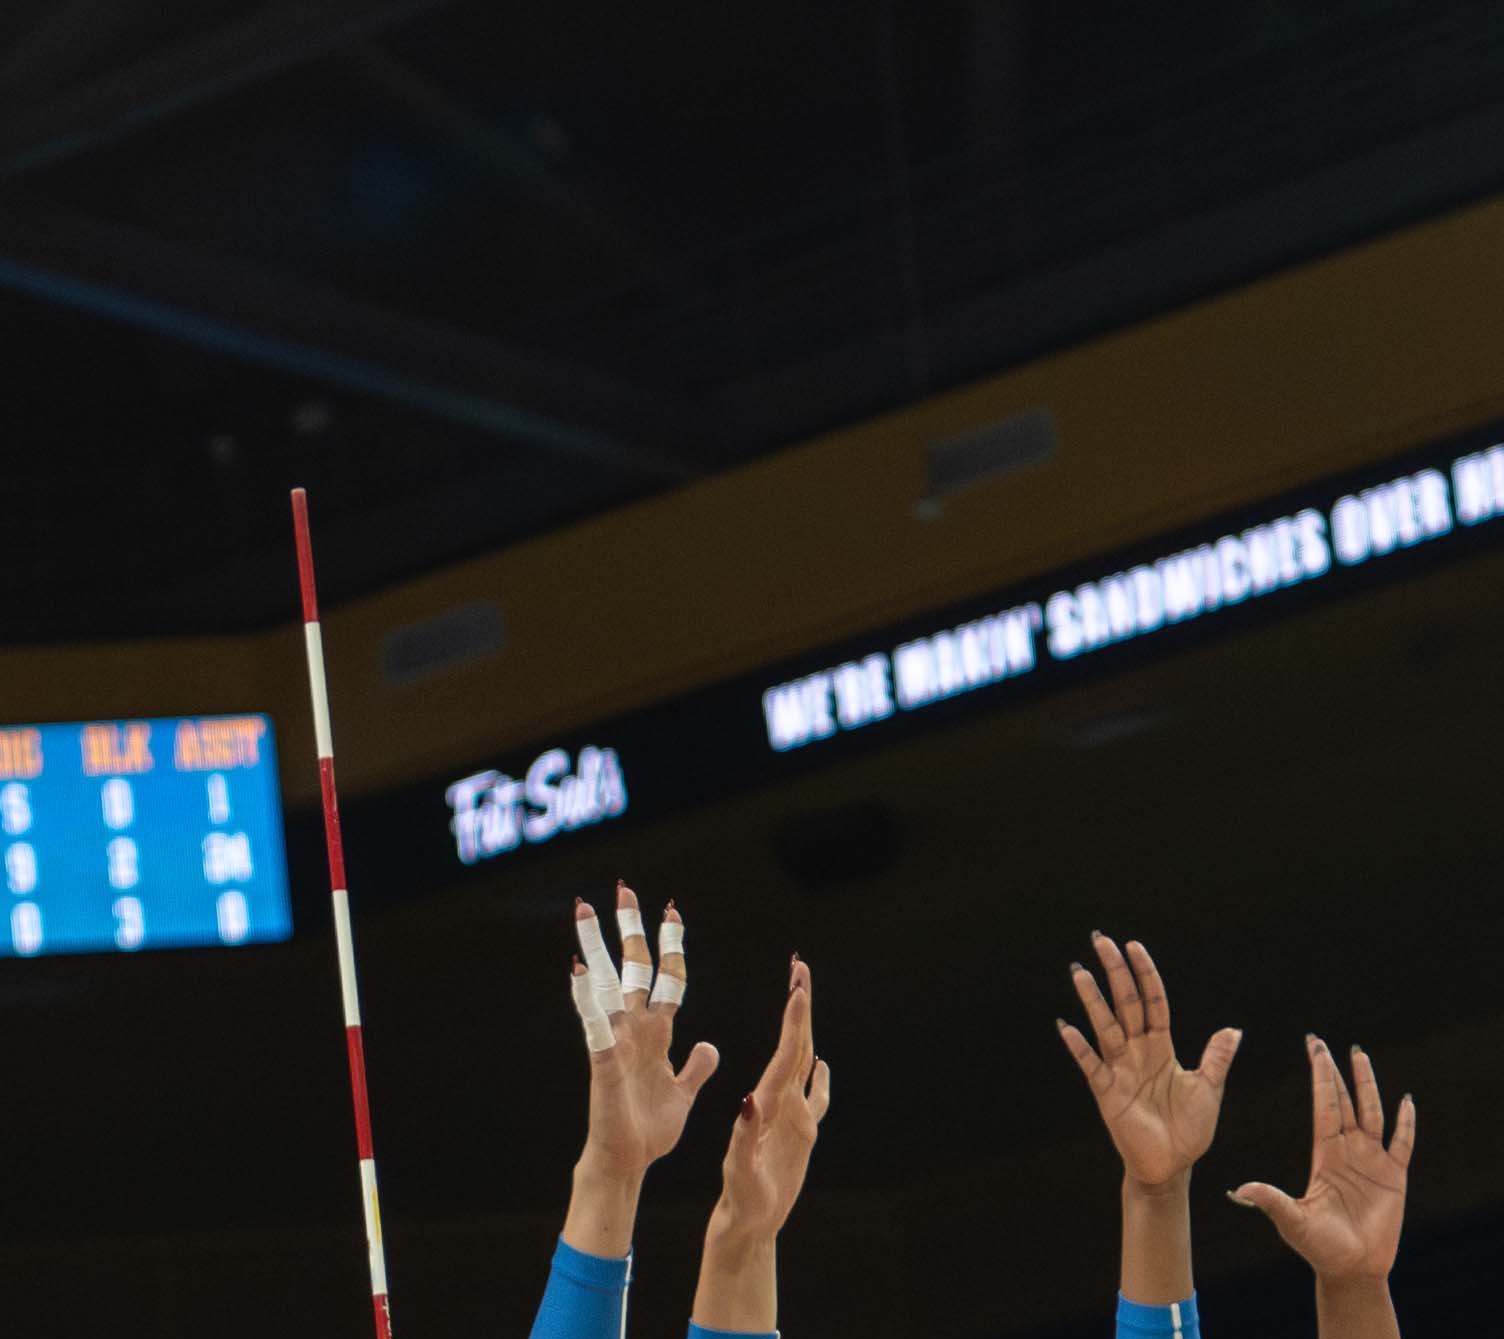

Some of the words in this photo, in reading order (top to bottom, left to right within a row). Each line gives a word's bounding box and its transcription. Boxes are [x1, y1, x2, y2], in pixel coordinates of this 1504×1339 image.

[762, 651, 895, 753] WE'RE
[892, 600, 1043, 711] MAKIN'
[1044, 507, 1330, 661] SANDWICHES
[1330, 468, 1453, 566] OVER
[445, 769, 526, 866] Fat
